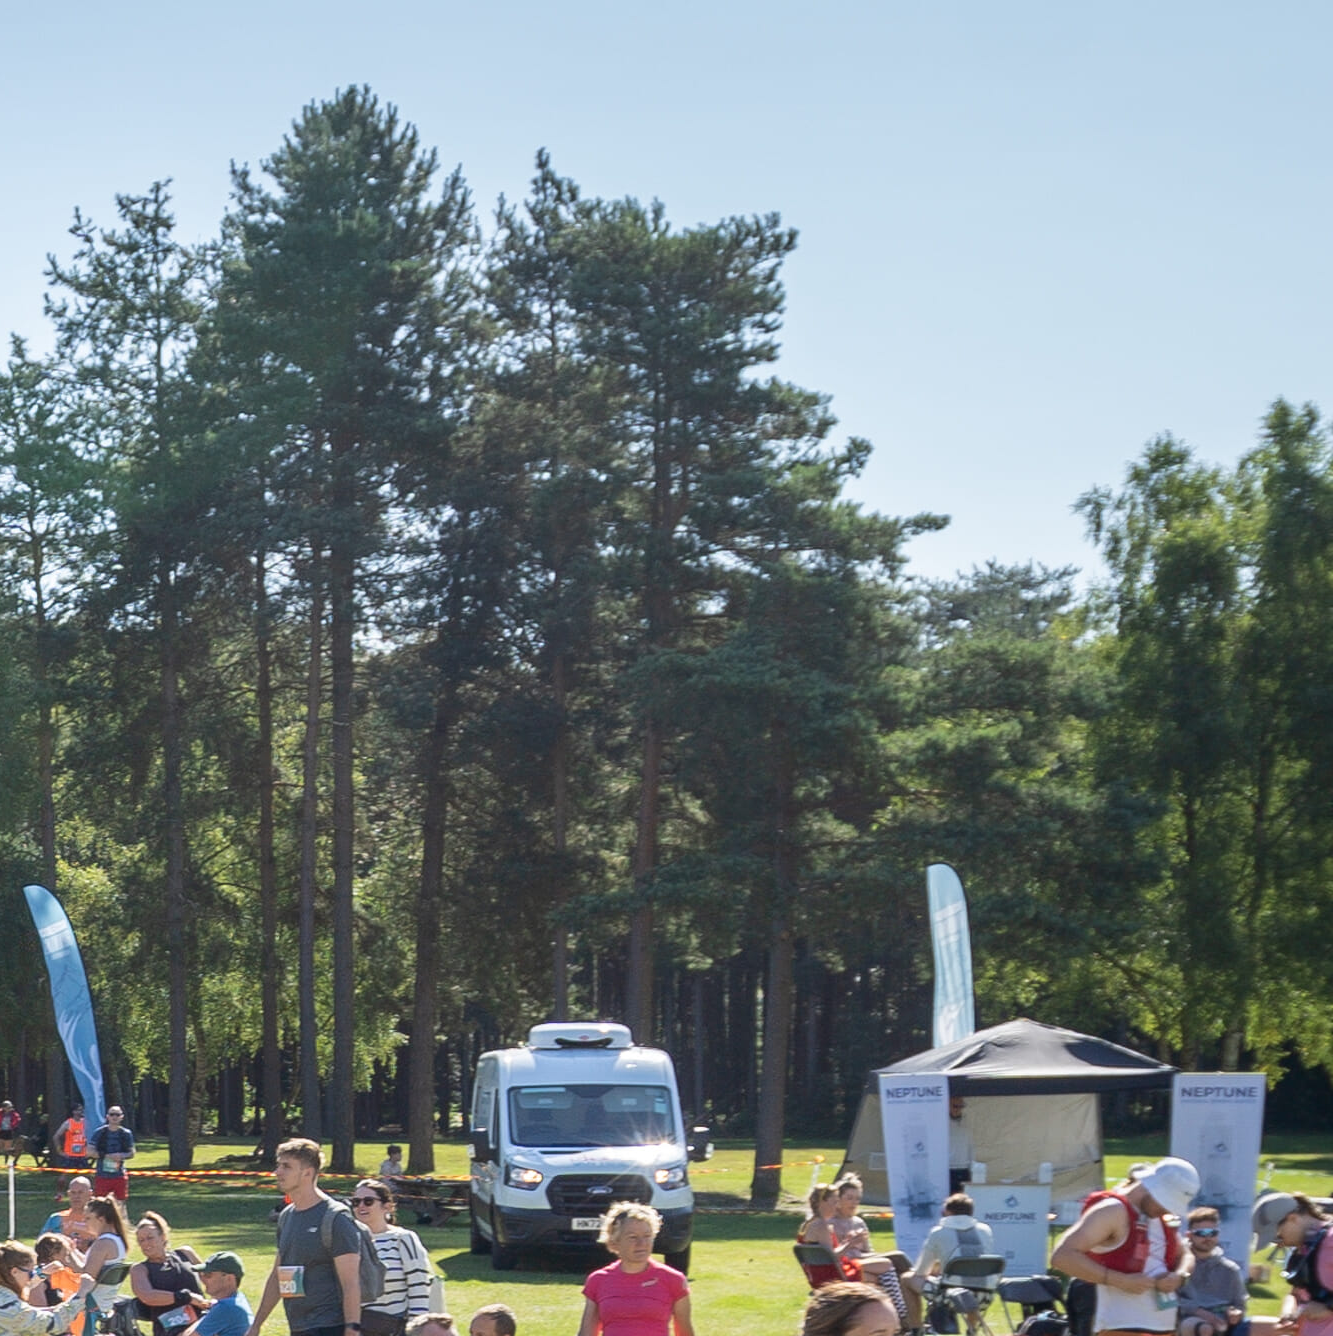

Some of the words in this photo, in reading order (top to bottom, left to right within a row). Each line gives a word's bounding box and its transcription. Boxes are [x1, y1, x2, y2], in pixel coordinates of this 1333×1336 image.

[886, 1086, 944, 1099] NEPTUNE
[1180, 1086, 1258, 1098] NEPTUNE
[984, 1211, 1037, 1221] NEPTUNE
